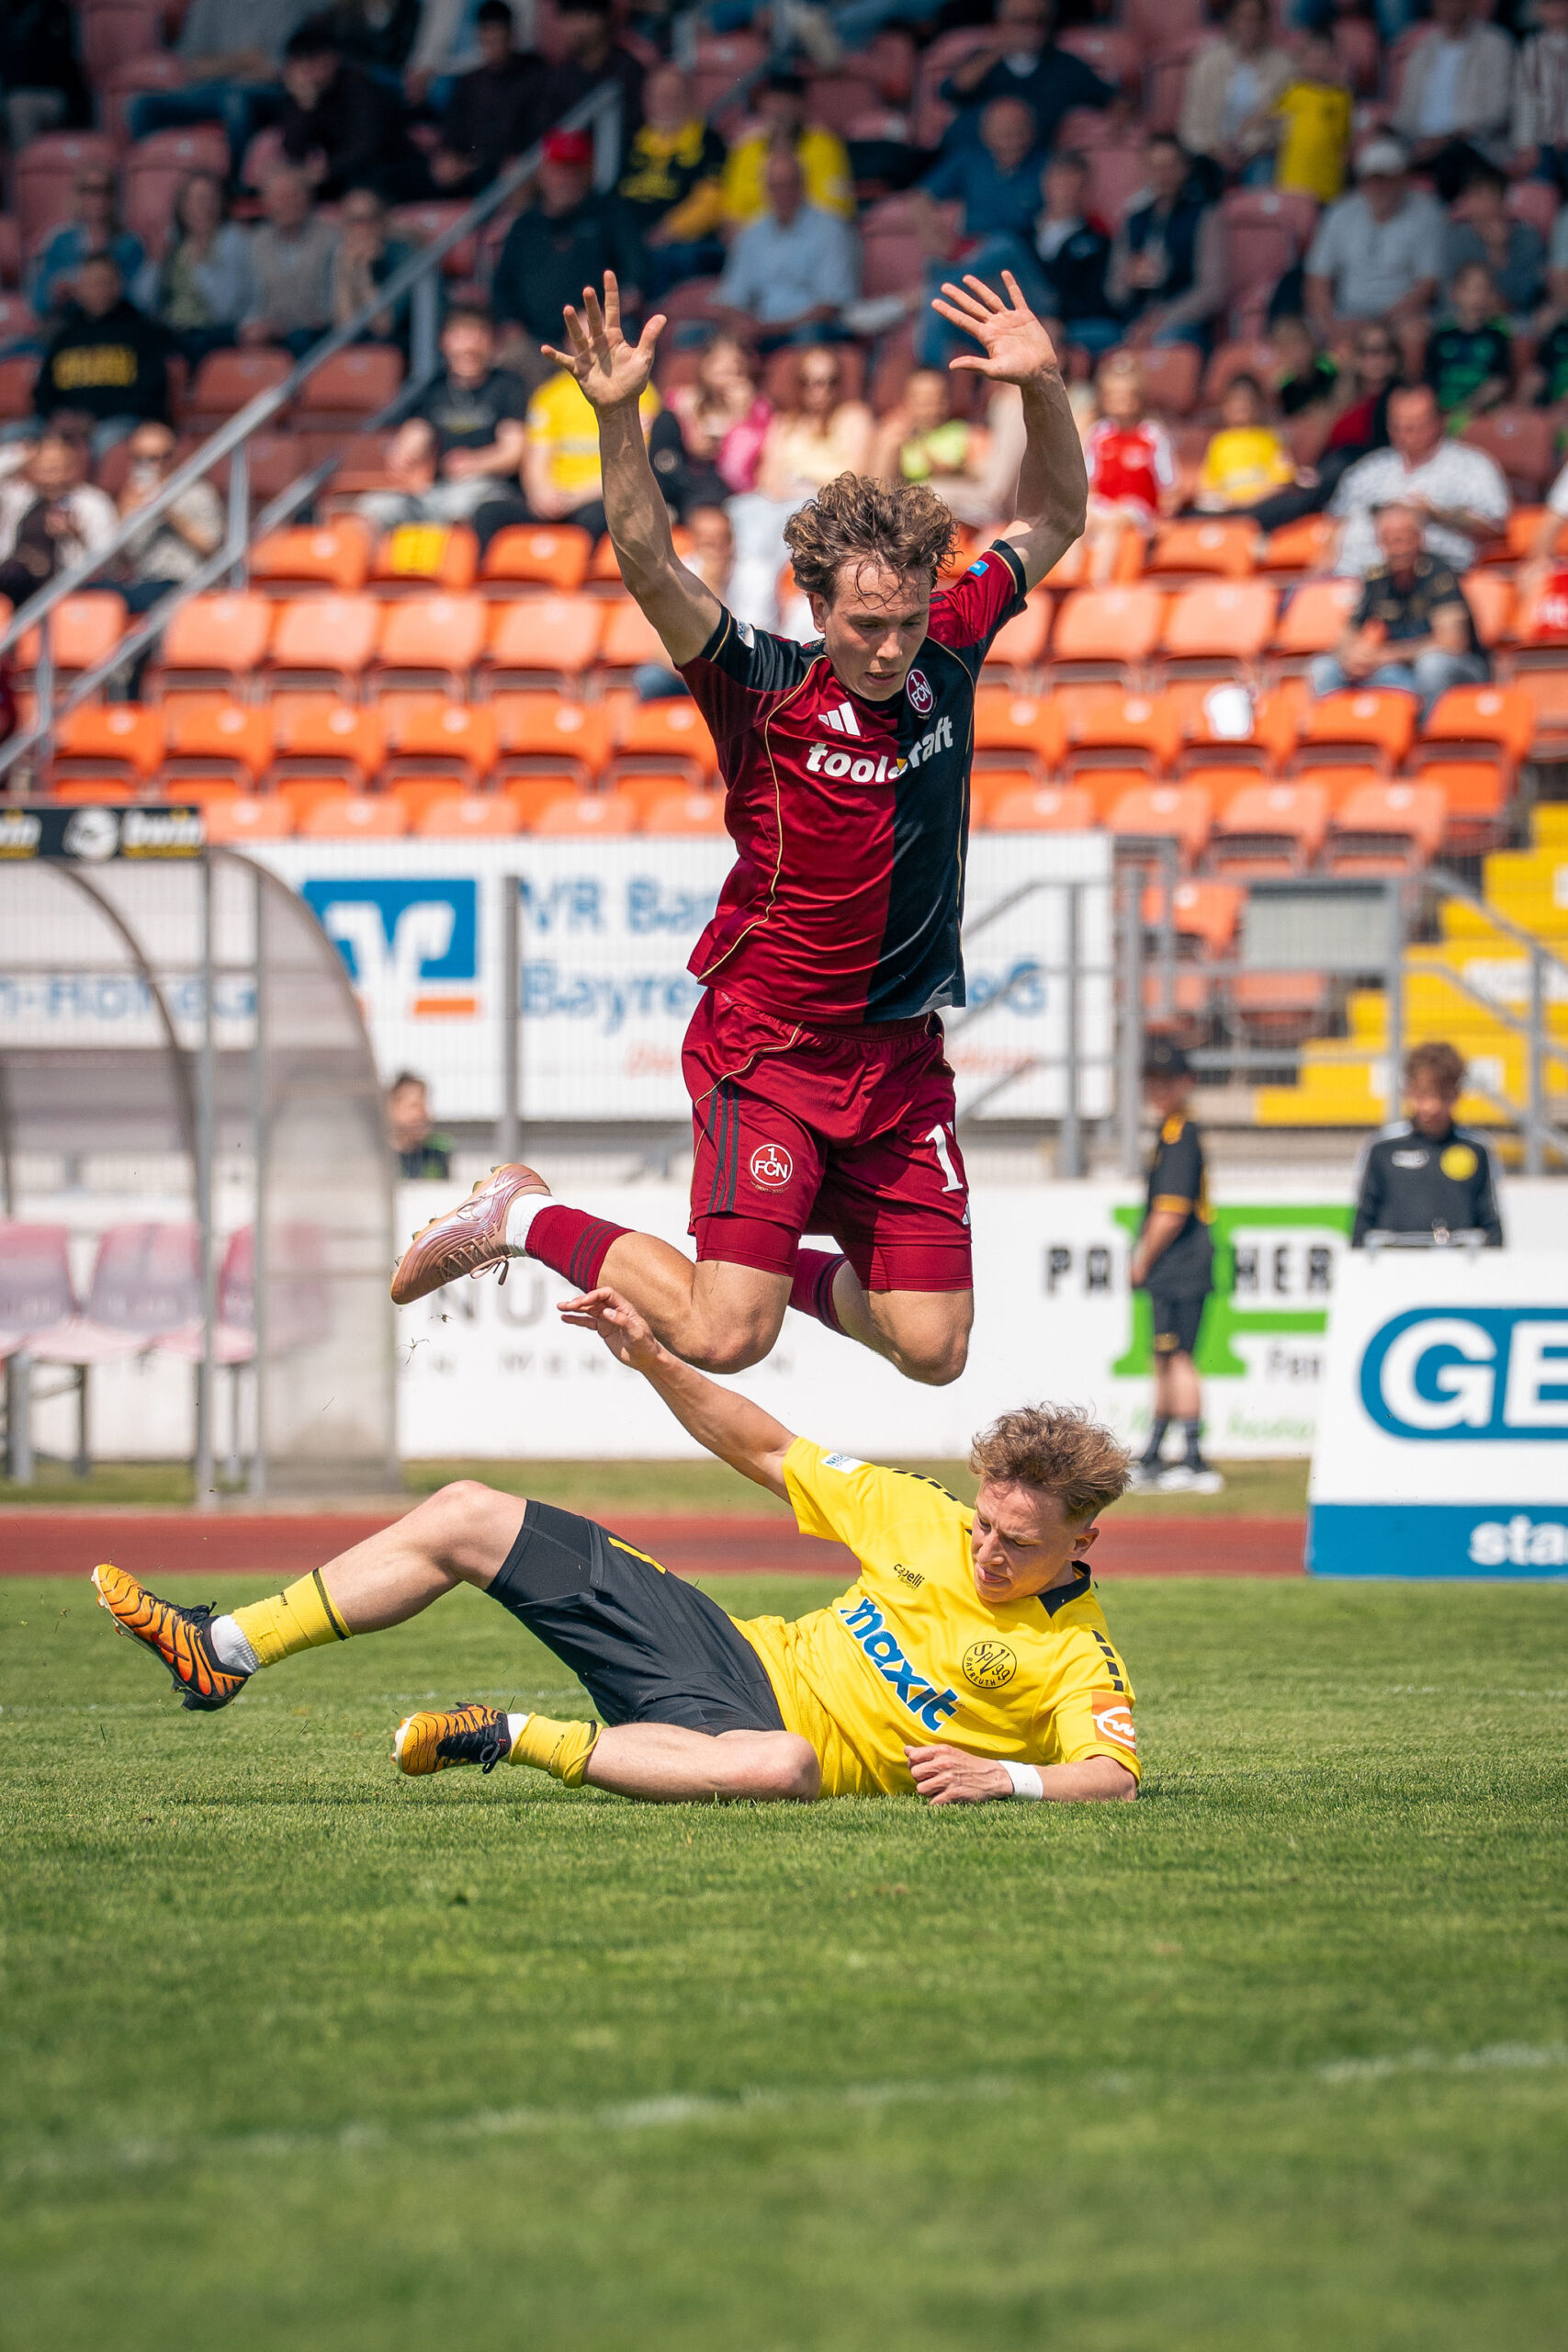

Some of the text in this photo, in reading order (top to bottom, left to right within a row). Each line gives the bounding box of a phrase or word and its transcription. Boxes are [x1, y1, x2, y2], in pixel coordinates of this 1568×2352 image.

[755, 1159, 788, 1180] FCN
[840, 1597, 960, 1733] maxit
[965, 1657, 996, 1687] BAYREUTH
